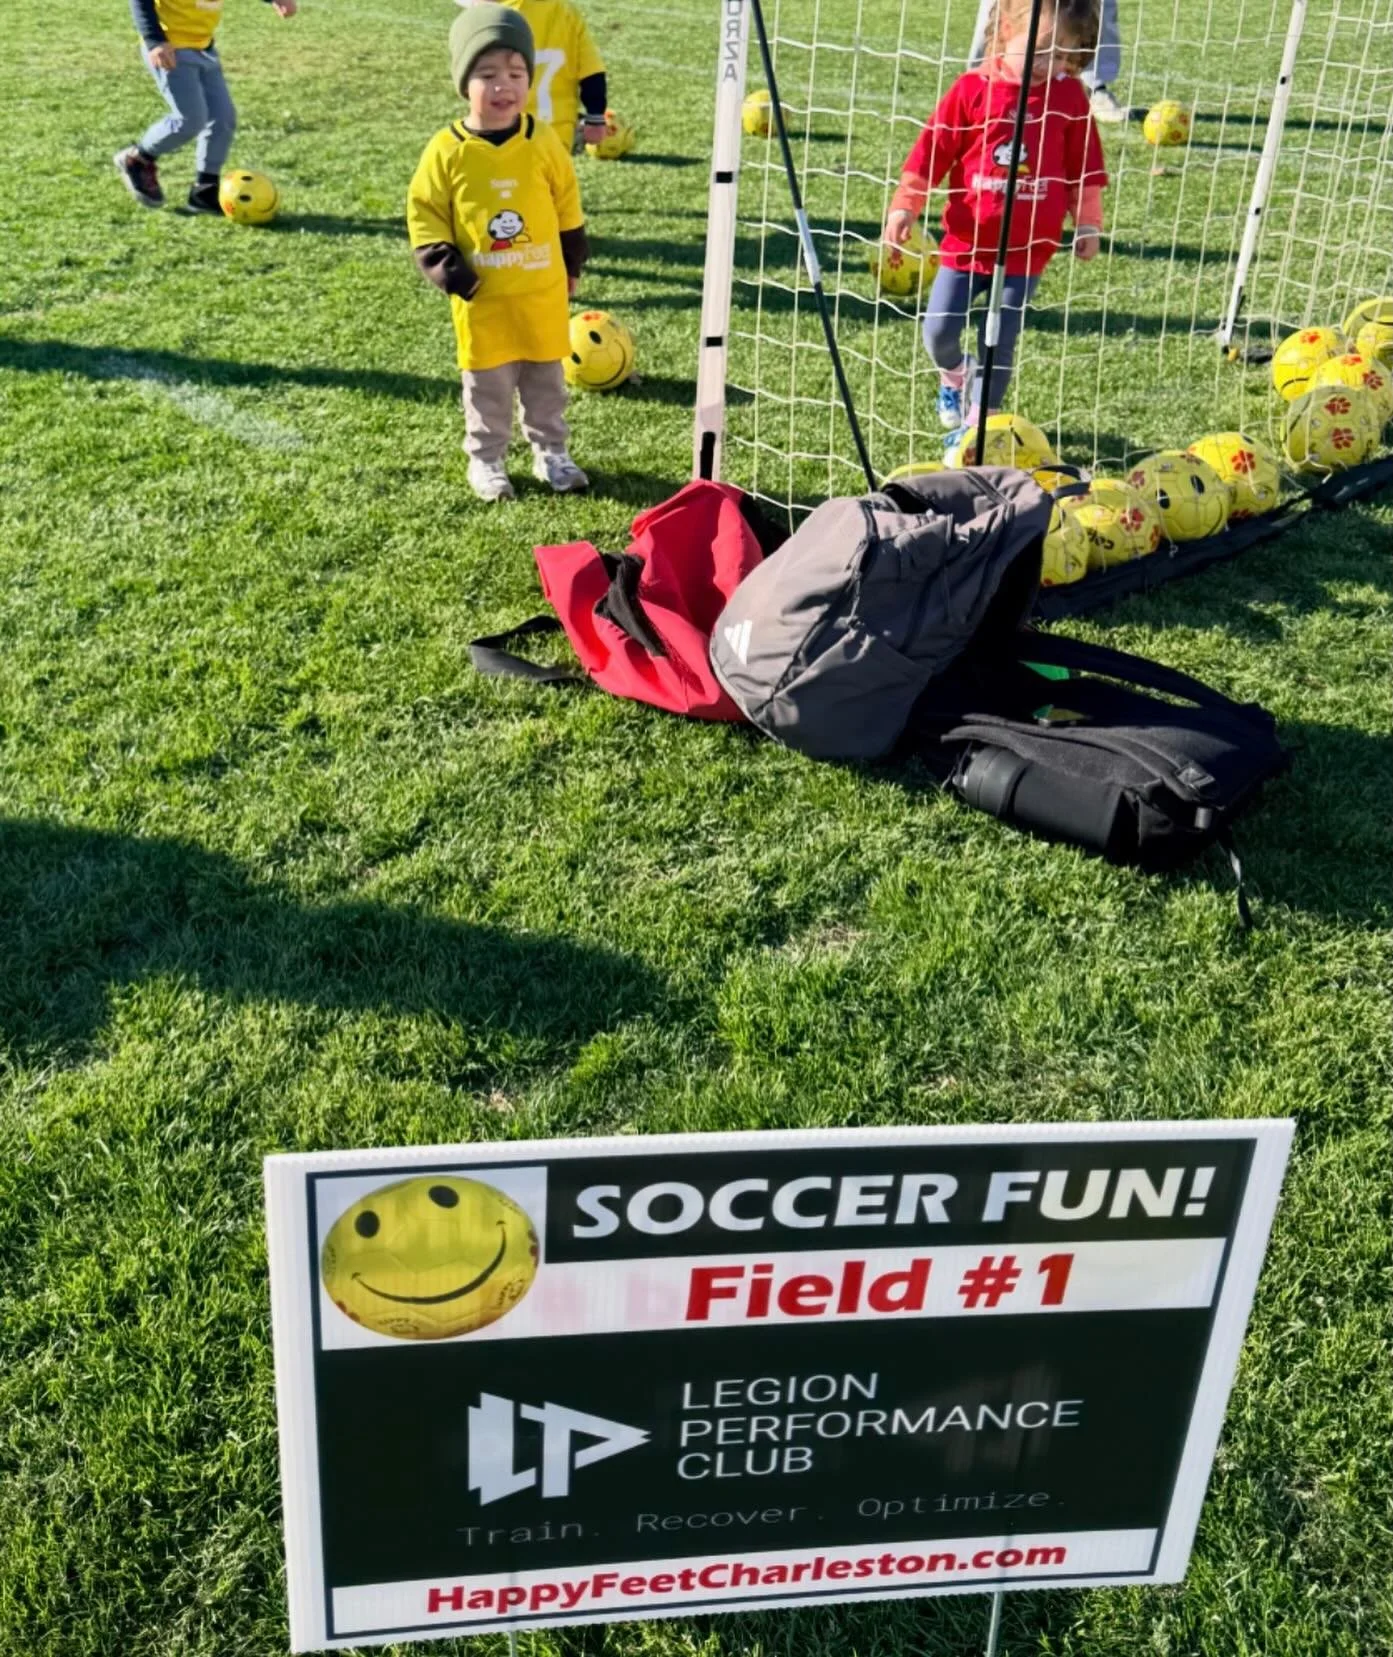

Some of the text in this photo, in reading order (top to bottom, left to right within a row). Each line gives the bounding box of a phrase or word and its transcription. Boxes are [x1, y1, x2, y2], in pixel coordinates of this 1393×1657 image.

[533, 48, 567, 122] 7
[573, 1167, 1217, 1237] SOCCER FUN!
[686, 1254, 1075, 1321] Field #1
[683, 1373, 878, 1409] LEGION
[680, 1400, 1084, 1447] PERFORMANCE
[677, 1447, 813, 1480] CLUB
[456, 1492, 1065, 1546] Train. Recover. Optimize.
[427, 1546, 1067, 1614] HappyFeetCharleston.com
